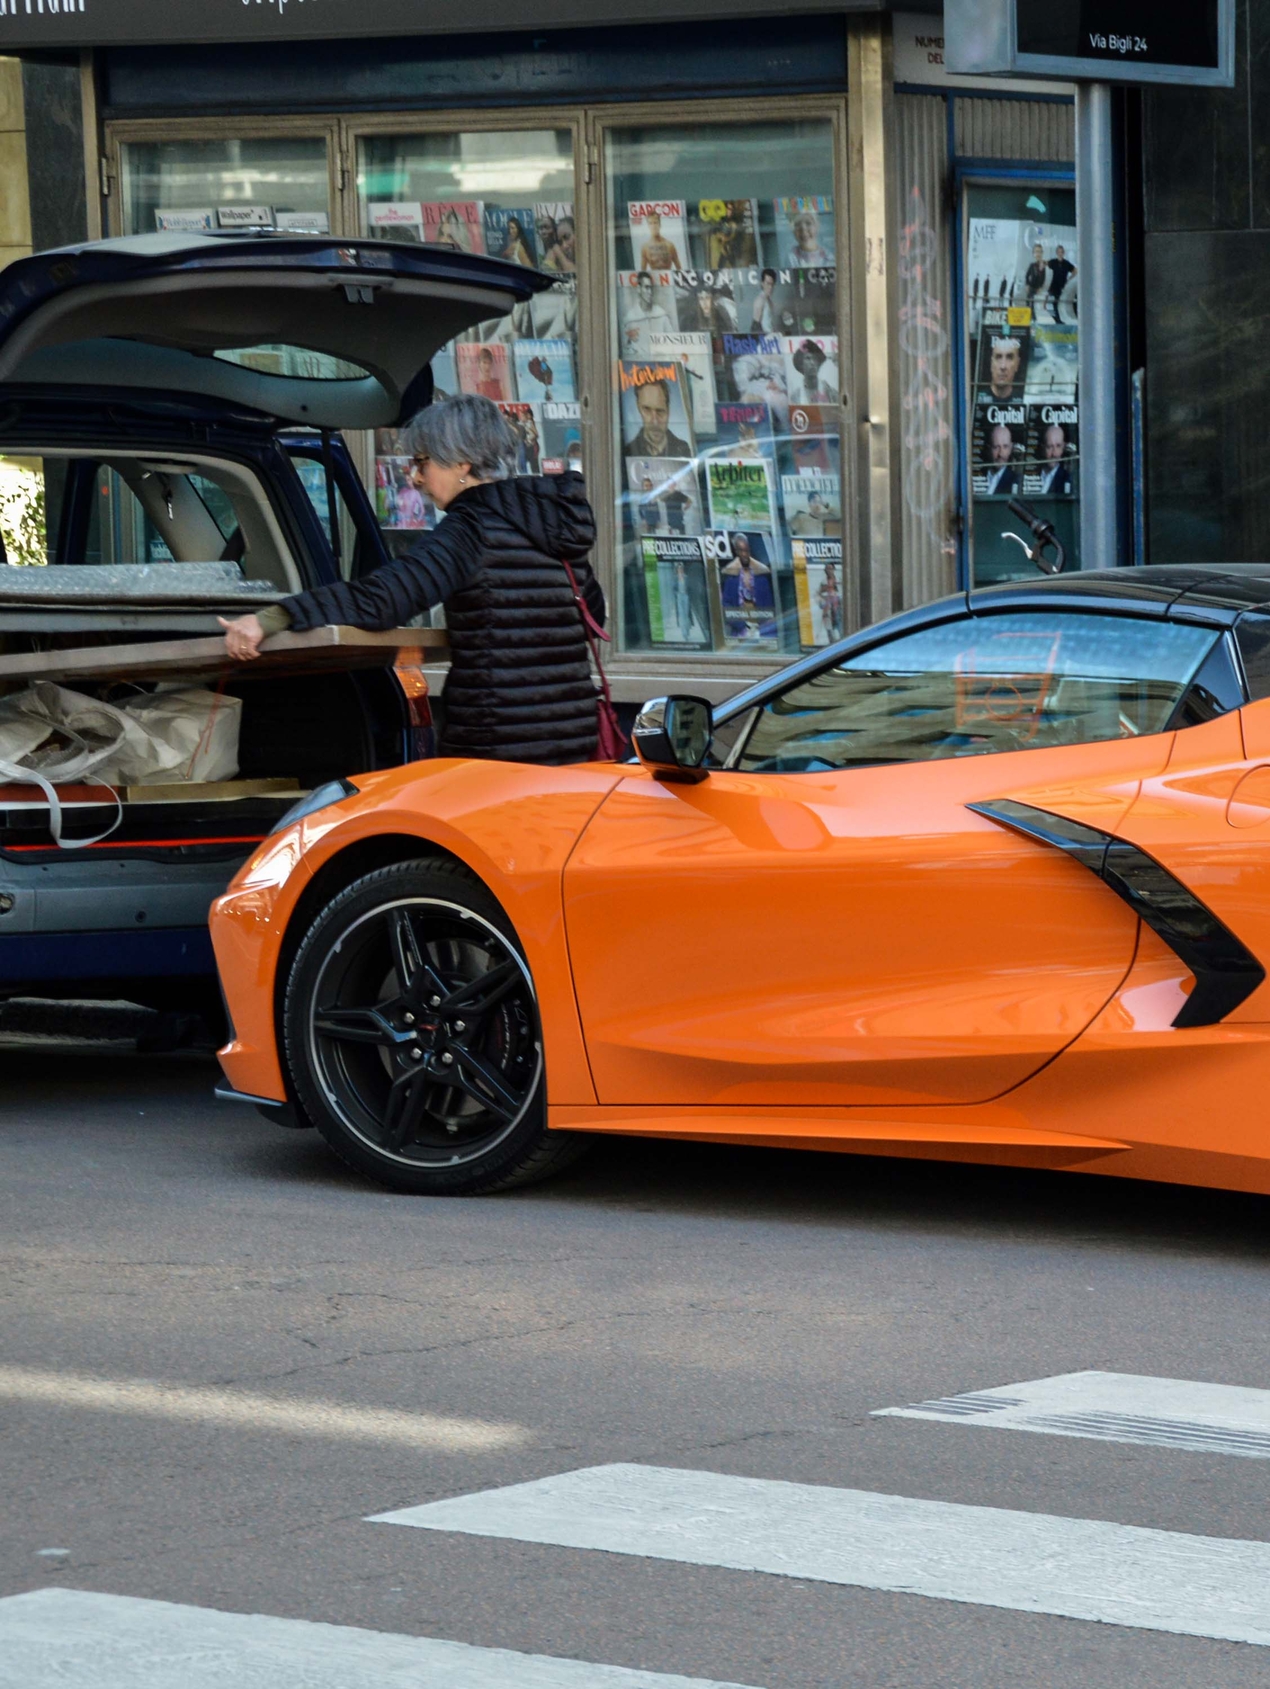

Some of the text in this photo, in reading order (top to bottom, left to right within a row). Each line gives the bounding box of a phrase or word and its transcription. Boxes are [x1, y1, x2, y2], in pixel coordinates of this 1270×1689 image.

[1090, 33, 1148, 54] Via Bigli 24
[724, 334, 782, 355] Flash Art
[987, 405, 1025, 428] Capital
[1041, 405, 1078, 428] Capital
[713, 462, 765, 485] Arbiter
